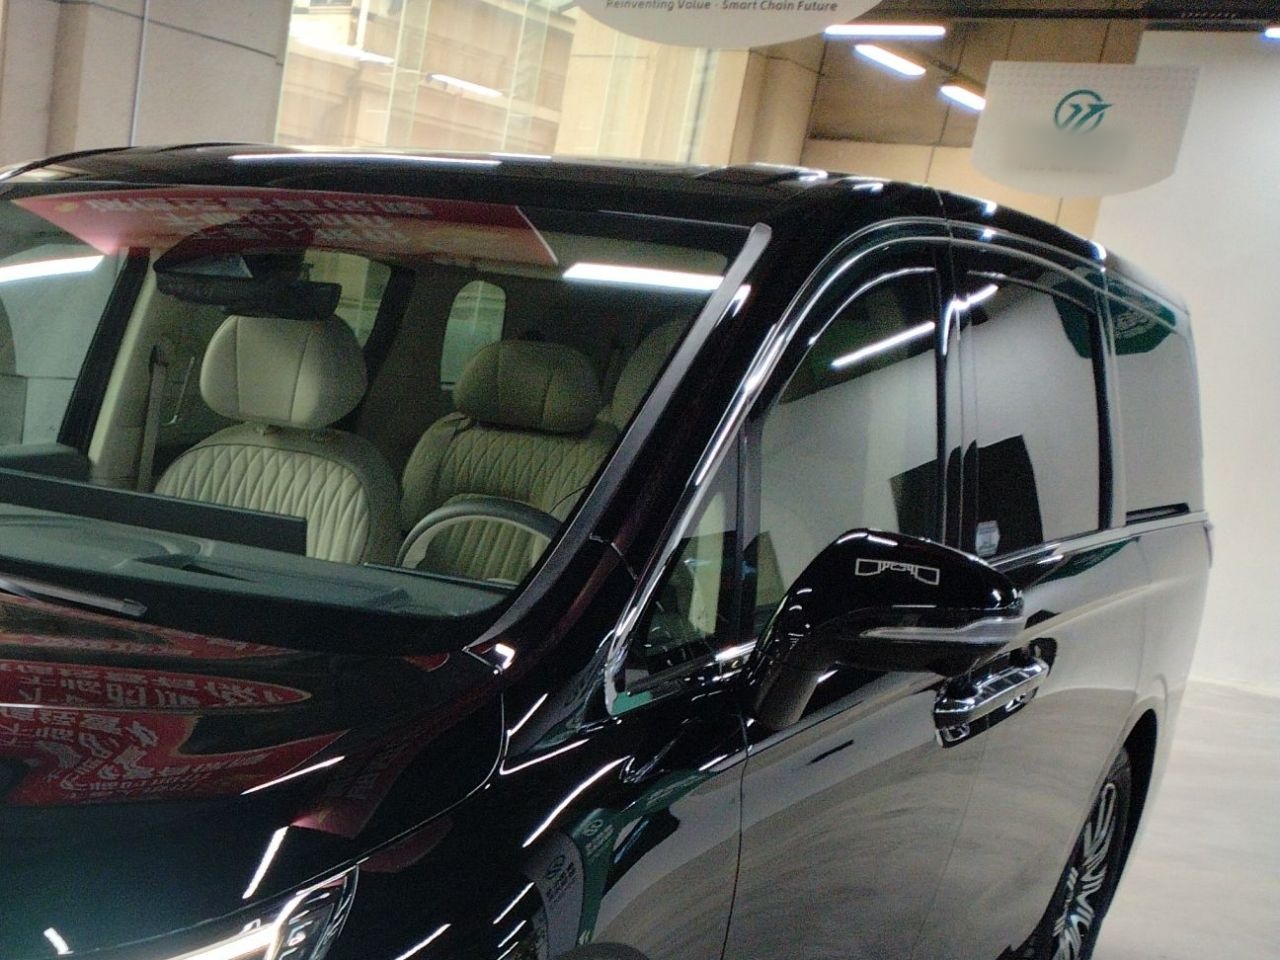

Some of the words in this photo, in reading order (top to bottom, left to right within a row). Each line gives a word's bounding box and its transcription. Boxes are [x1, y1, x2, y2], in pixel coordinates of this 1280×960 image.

[678, 0, 711, 9] Value
[721, 0, 757, 9] Smart
[760, 0, 794, 10] Chain
[797, 1, 838, 11] Future
